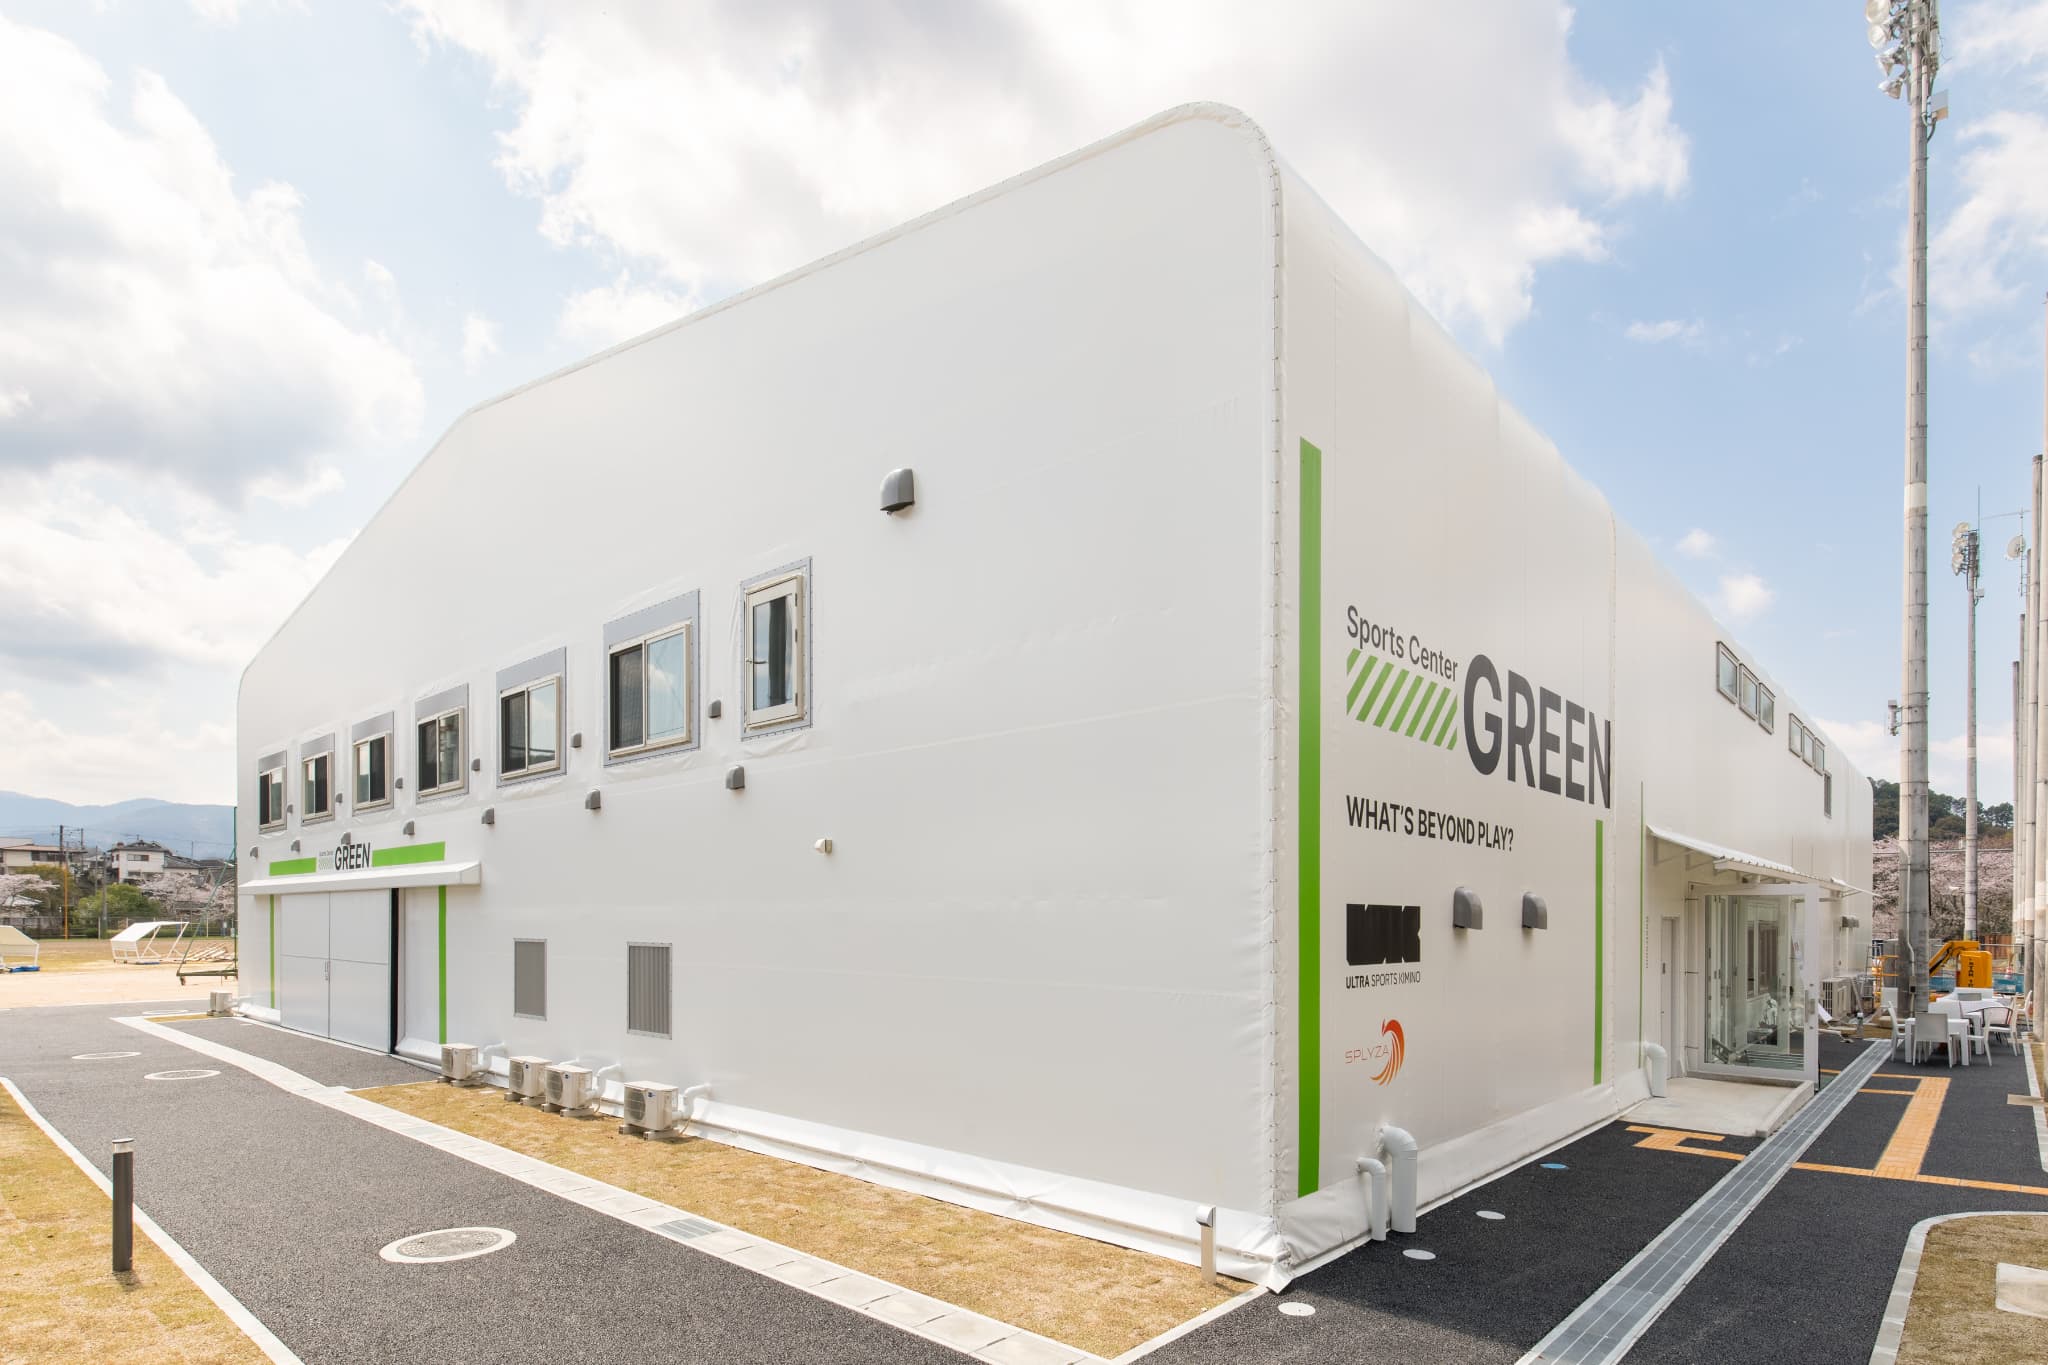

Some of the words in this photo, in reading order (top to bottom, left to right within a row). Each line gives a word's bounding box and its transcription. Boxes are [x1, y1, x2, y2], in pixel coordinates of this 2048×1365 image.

[1346, 604, 1405, 659] Sports
[1408, 634, 1459, 682] Center
[1463, 654, 1612, 809] GREEN
[1346, 794, 1414, 836] WHAT'S
[1417, 808, 1476, 845] BEYOND
[1477, 820, 1515, 852] PLAY?
[334, 842, 371, 871] GREEN
[1345, 974, 1370, 990] ULTRA
[1371, 972, 1398, 987] SPORTS
[1398, 970, 1421, 985] KIMINO
[1344, 1044, 1390, 1064] SPLYZA
